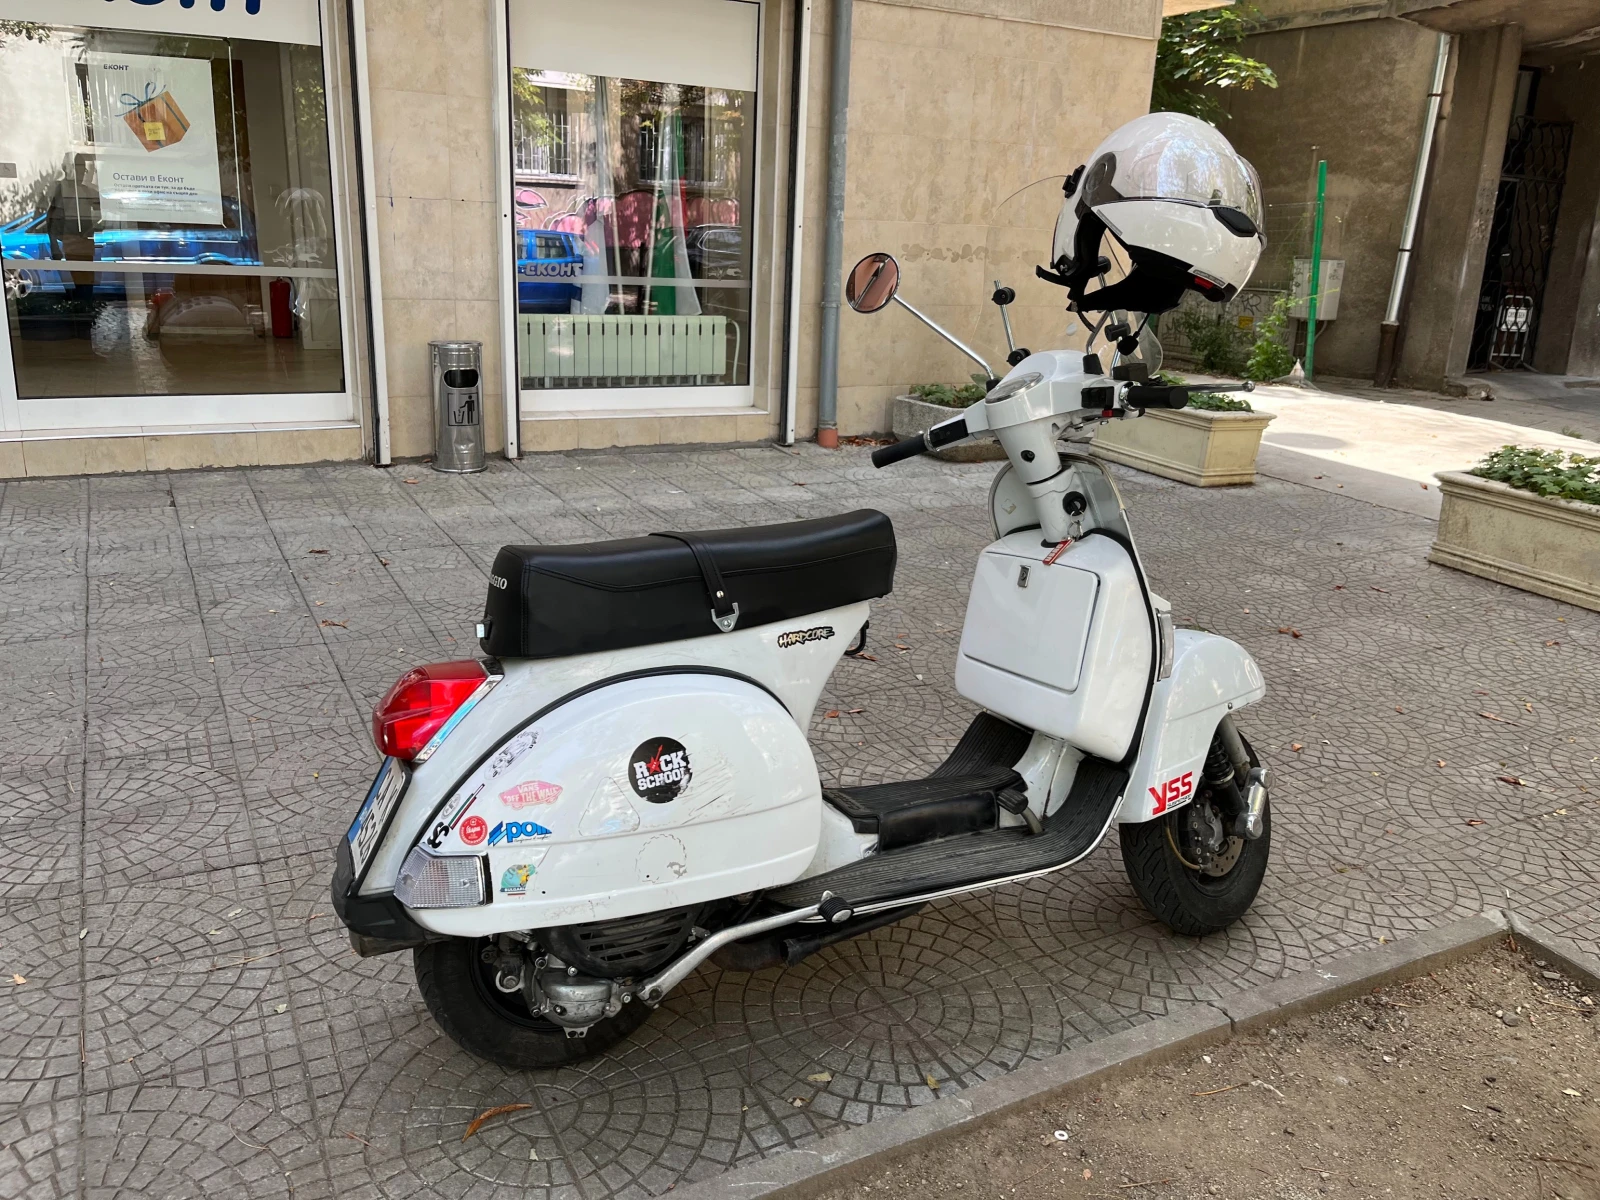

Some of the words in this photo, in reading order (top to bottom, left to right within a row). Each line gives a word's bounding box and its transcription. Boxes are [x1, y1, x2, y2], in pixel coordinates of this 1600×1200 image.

[103, 63, 129, 71] ЕКОНТ
[112, 172, 148, 182] Остави
[149, 174, 156, 182] в
[157, 174, 185, 184] Еконт
[777, 626, 836, 648] HARDCORE
[517, 782, 540, 794] VANS
[520, 790, 539, 803] THE
